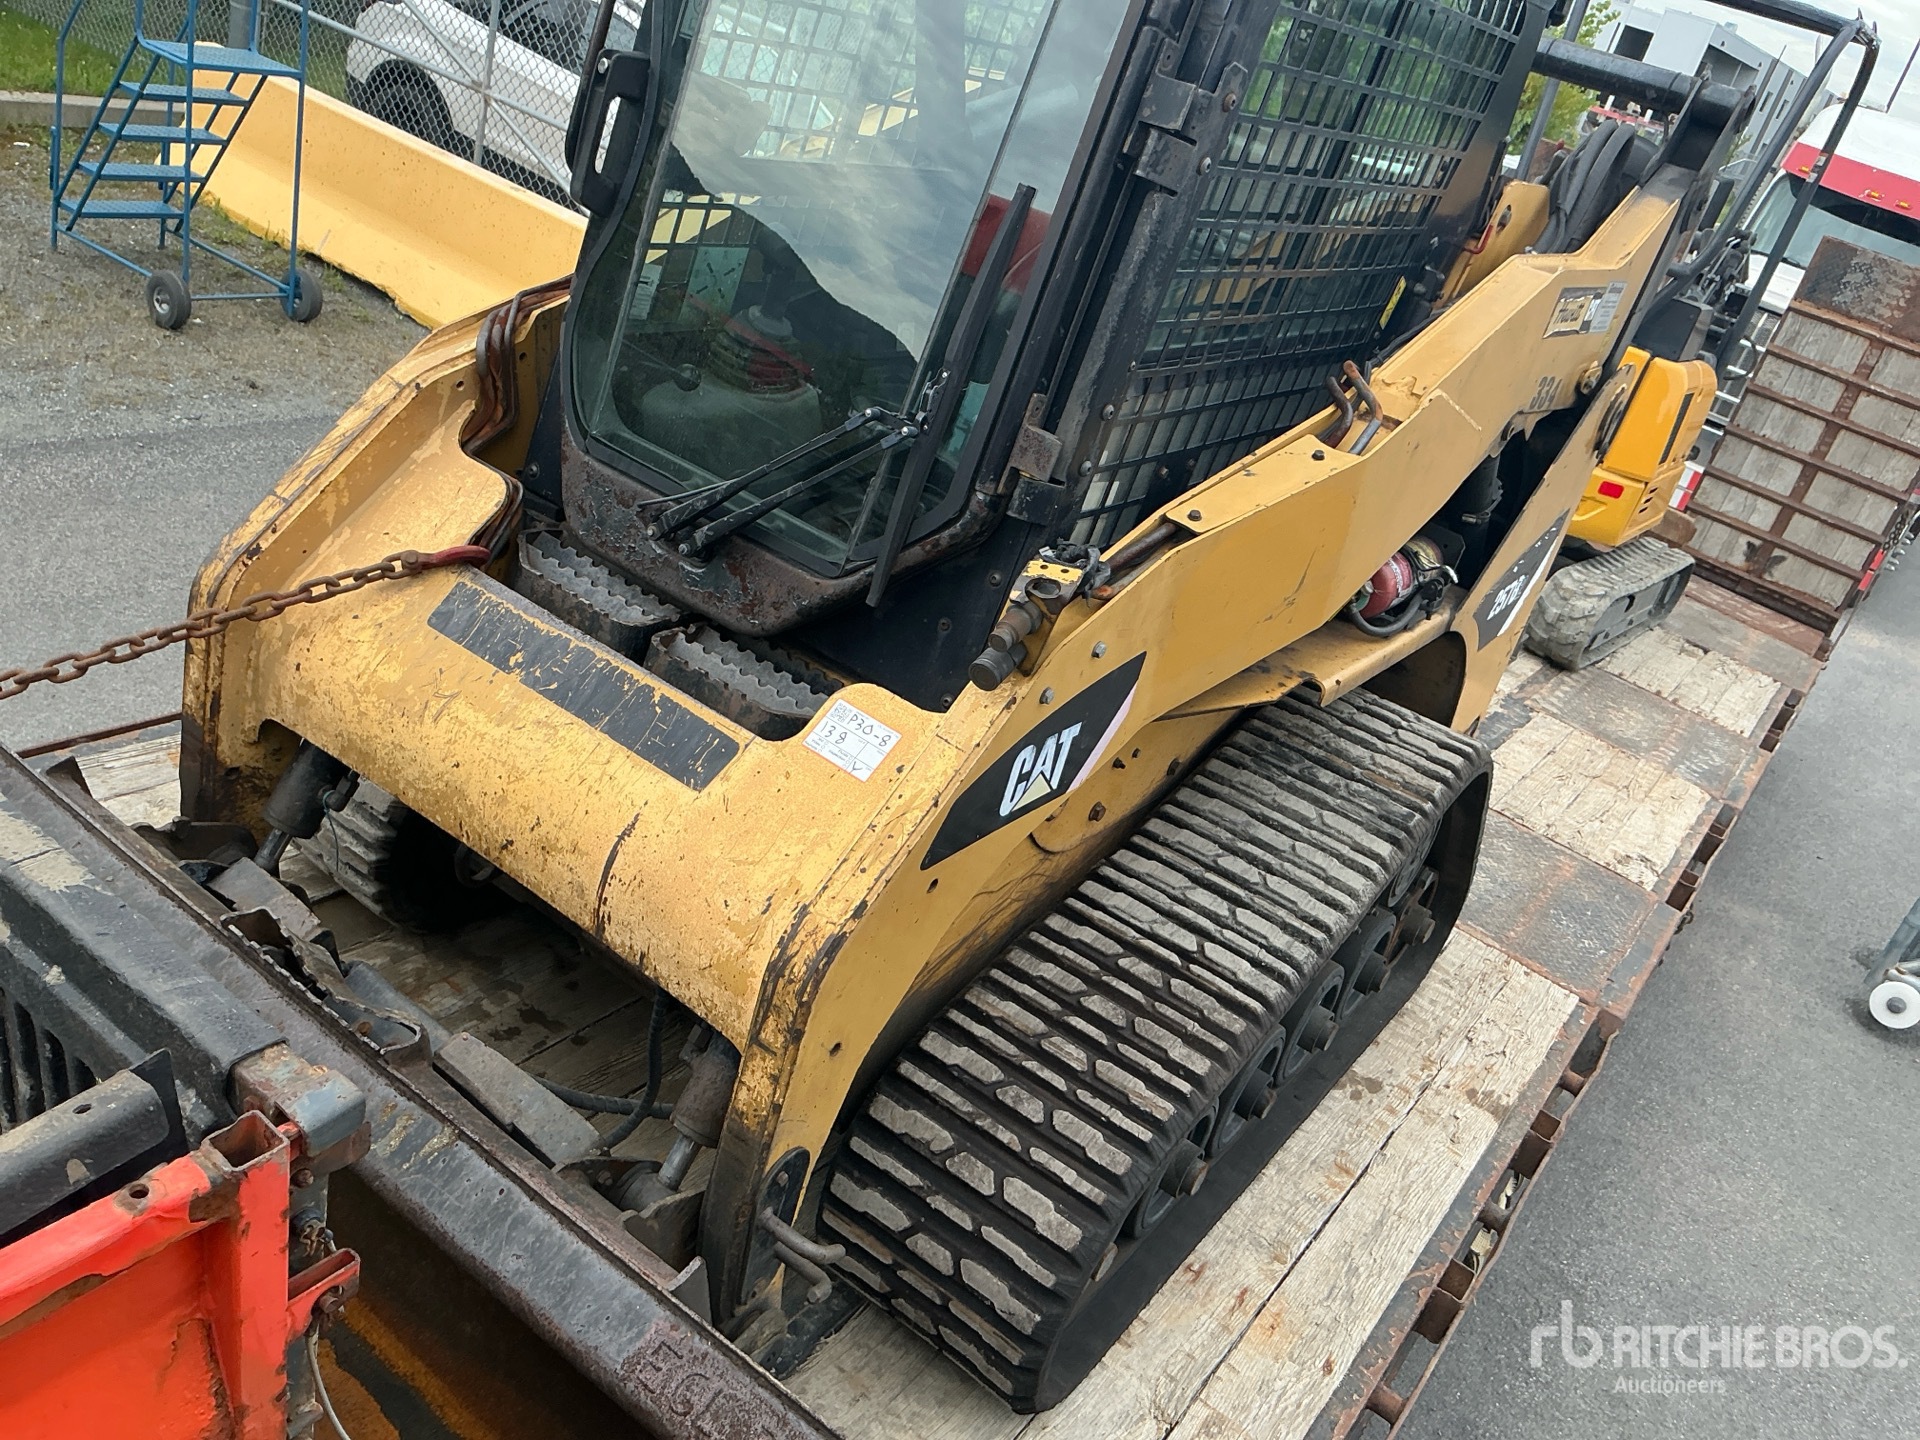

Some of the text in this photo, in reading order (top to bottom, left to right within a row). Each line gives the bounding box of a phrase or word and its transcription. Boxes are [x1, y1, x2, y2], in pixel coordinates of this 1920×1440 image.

[1528, 376, 1562, 410] 334
[821, 720, 847, 744] 138
[847, 713, 892, 747] P30-8
[999, 721, 1083, 817] CAT
